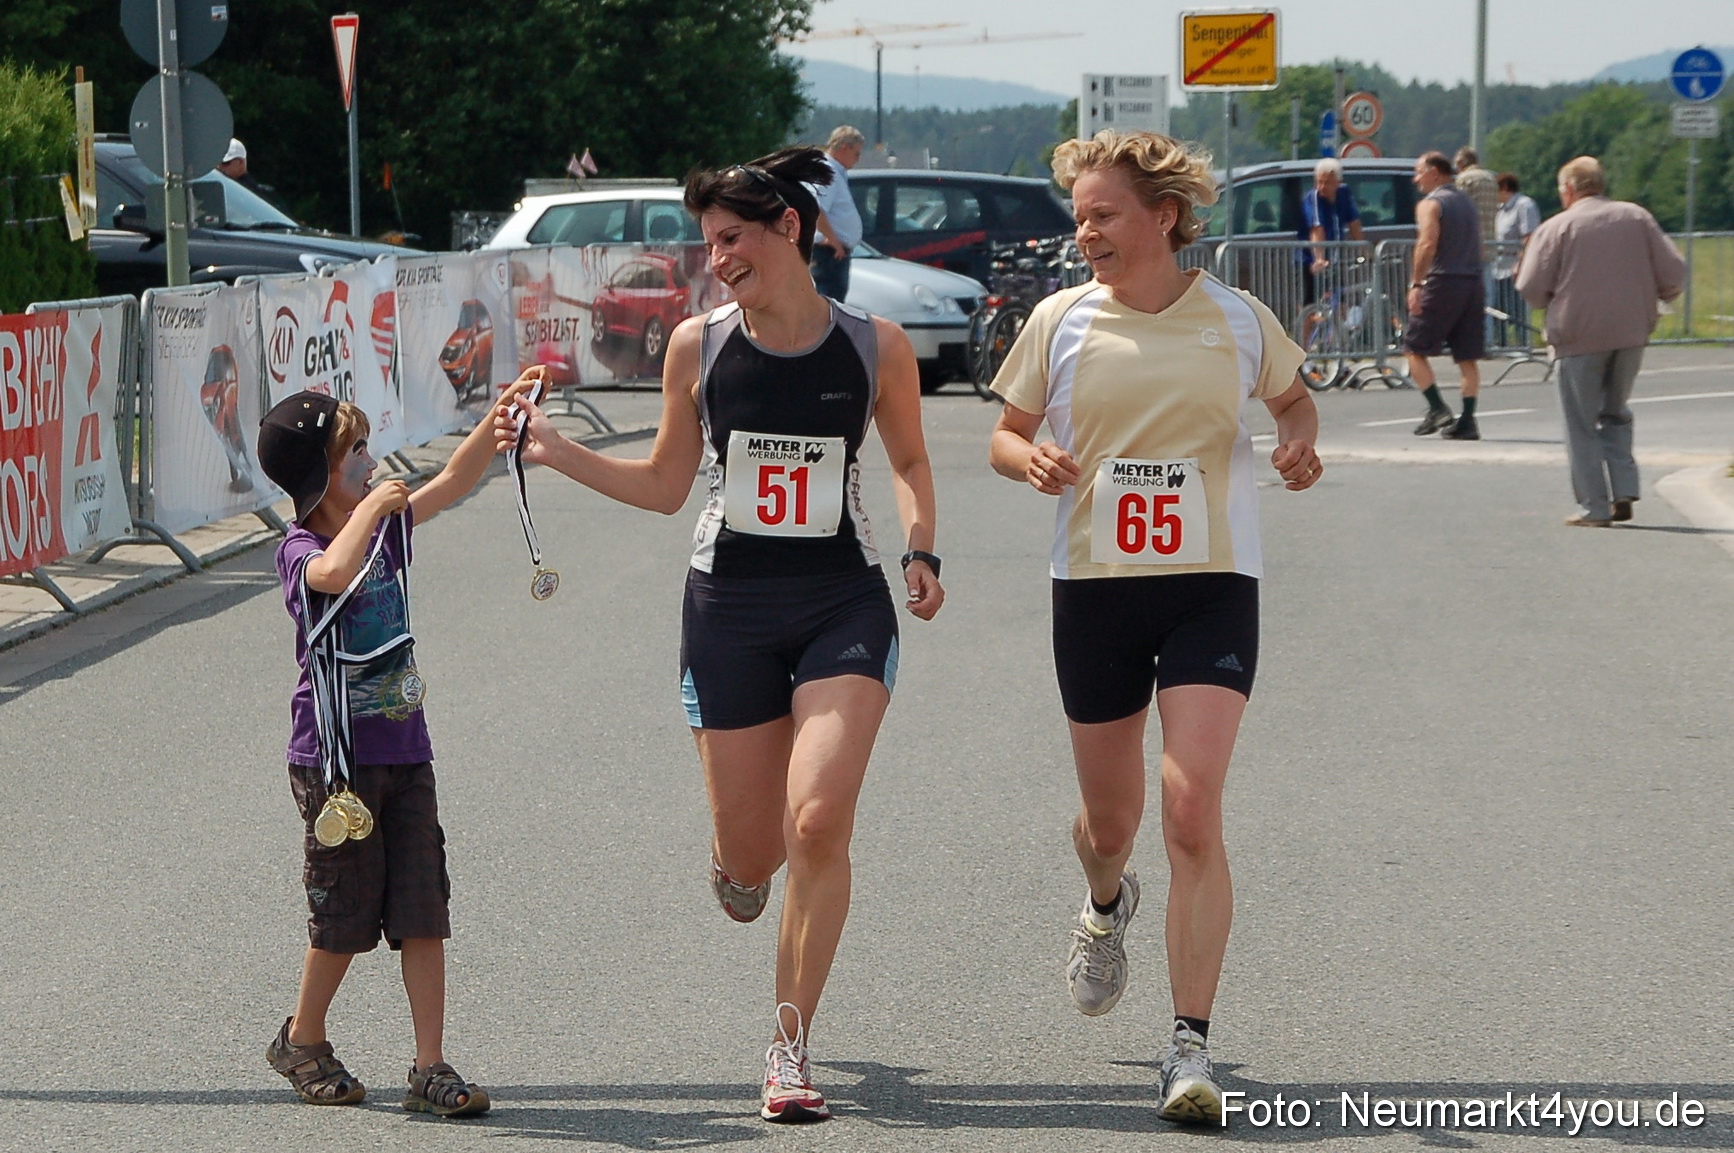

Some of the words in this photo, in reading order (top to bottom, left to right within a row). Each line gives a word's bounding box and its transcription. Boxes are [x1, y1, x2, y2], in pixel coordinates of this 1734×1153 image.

[1352, 105, 1373, 125] 60
[747, 438, 801, 452] MEYER
[747, 451, 801, 461] WERBUNG
[1112, 463, 1164, 477] MEYER
[1112, 476, 1165, 487] WERBUNG
[756, 465, 809, 526] 51
[1117, 493, 1183, 555] 65
